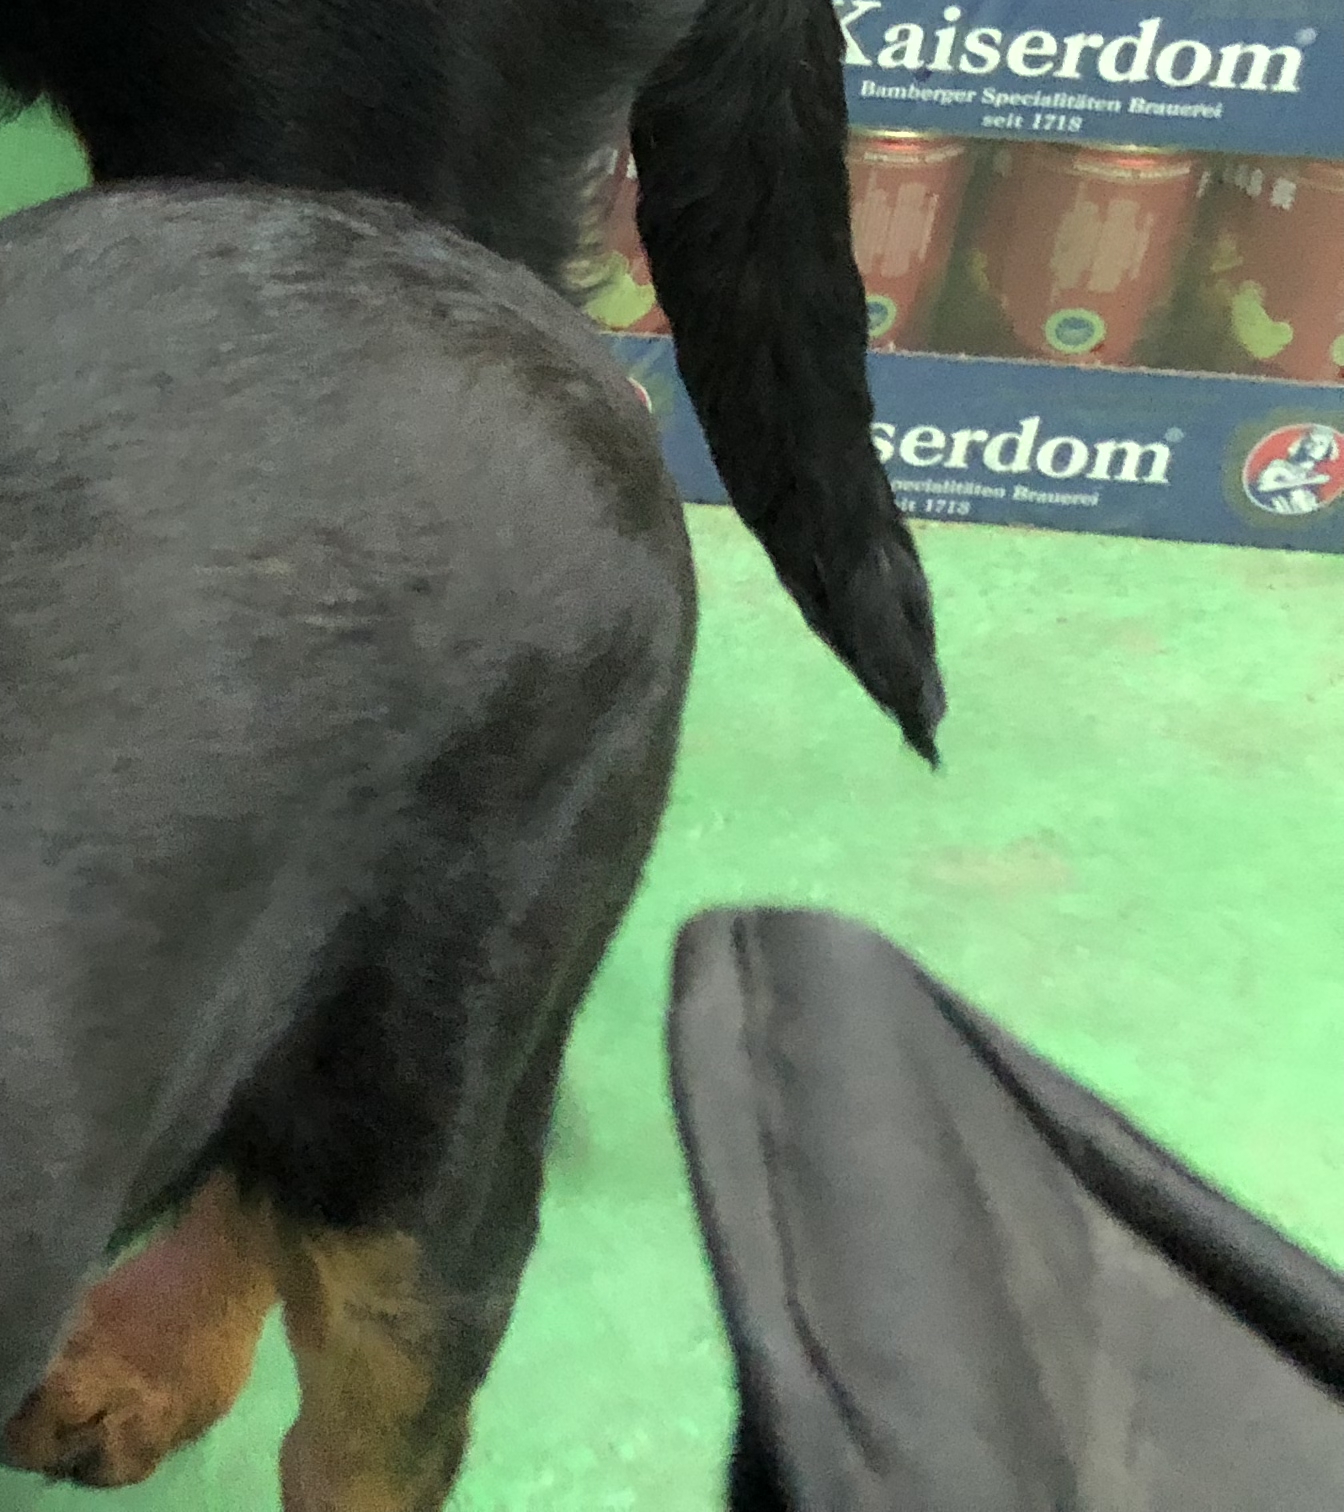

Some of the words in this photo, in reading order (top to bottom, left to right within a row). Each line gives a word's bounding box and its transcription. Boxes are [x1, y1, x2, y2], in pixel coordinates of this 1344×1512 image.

[861, 80, 977, 106] Bamberger
[981, 88, 1122, 114] Specialitäten
[1127, 96, 1224, 120] Brauerei
[982, 113, 1023, 131] seit
[1030, 114, 1083, 134] 1718
[1012, 481, 1099, 506] Brauerei
[923, 498, 971, 516] 1718
